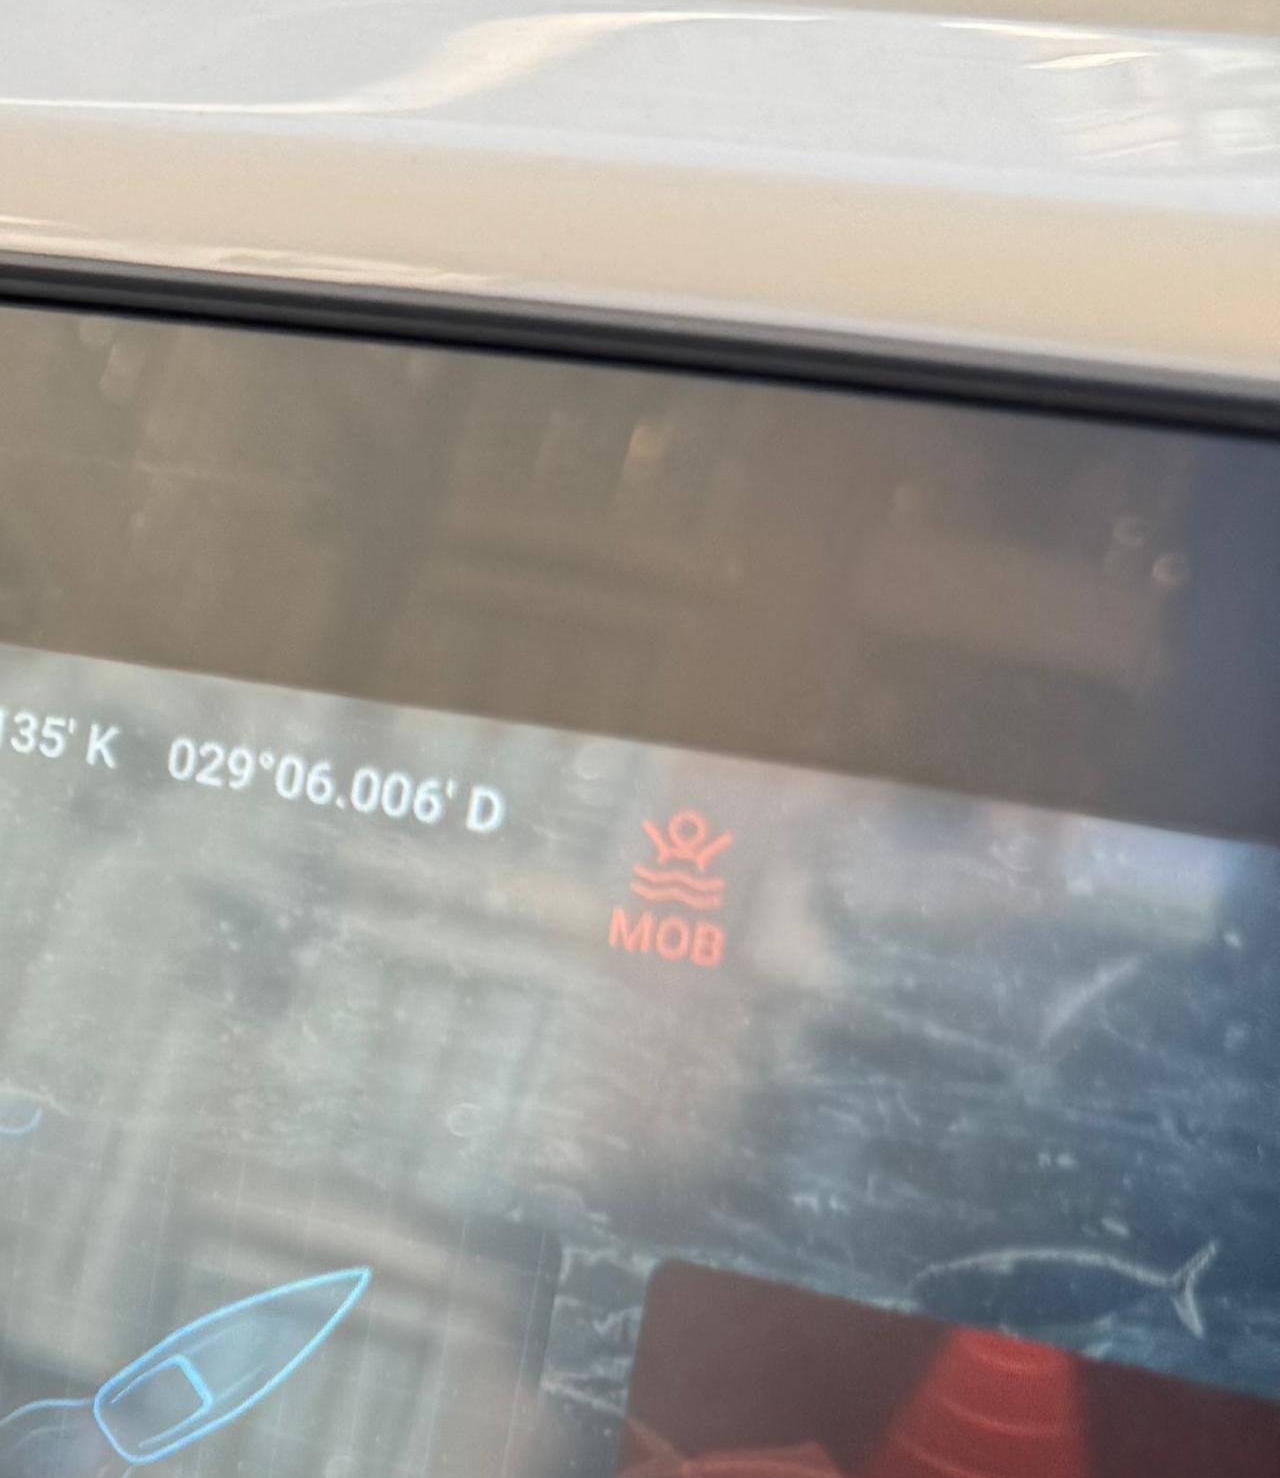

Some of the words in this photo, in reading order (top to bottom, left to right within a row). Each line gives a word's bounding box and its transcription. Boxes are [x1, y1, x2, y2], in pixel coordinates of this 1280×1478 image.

[85, 723, 120, 770] K
[465, 785, 506, 835] D
[608, 907, 725, 968] MOB
